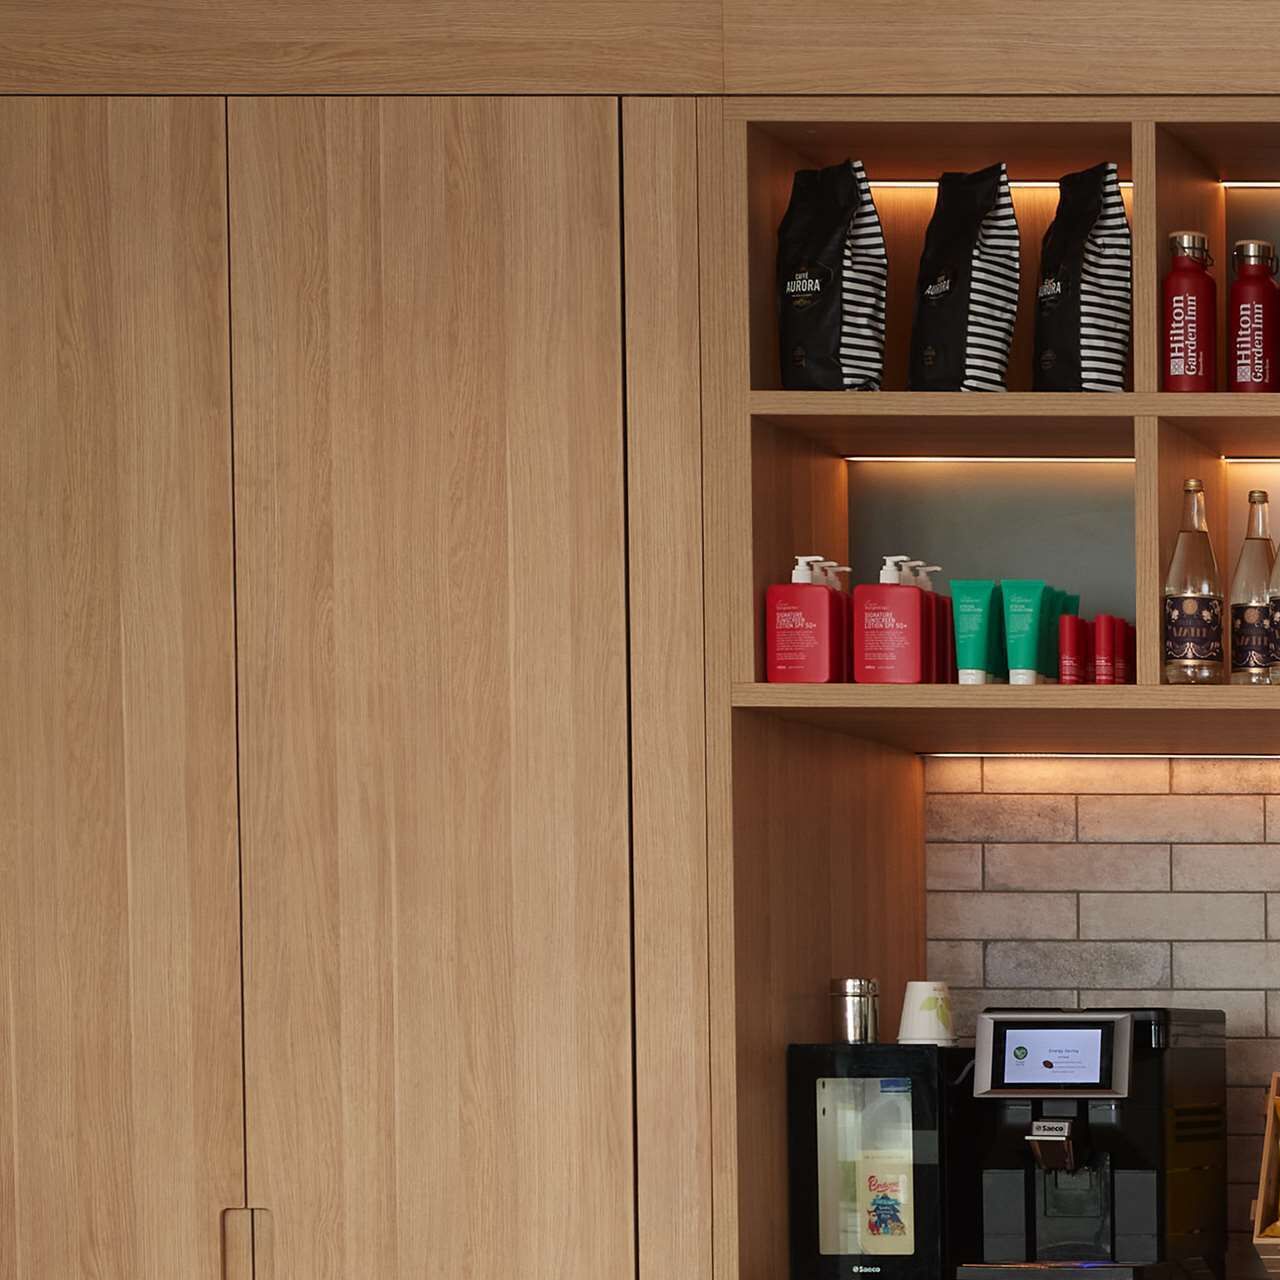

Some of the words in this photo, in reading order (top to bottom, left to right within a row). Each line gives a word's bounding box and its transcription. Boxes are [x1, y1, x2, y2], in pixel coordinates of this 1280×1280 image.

[786, 279, 821, 294] AURORA
[1185, 296, 1197, 320] Inn
[1170, 296, 1185, 358] Hilton
[1237, 303, 1251, 365] Hilton
[1252, 303, 1263, 328] Inn
[1185, 323, 1197, 376] Garden
[1252, 331, 1263, 383] Garden
